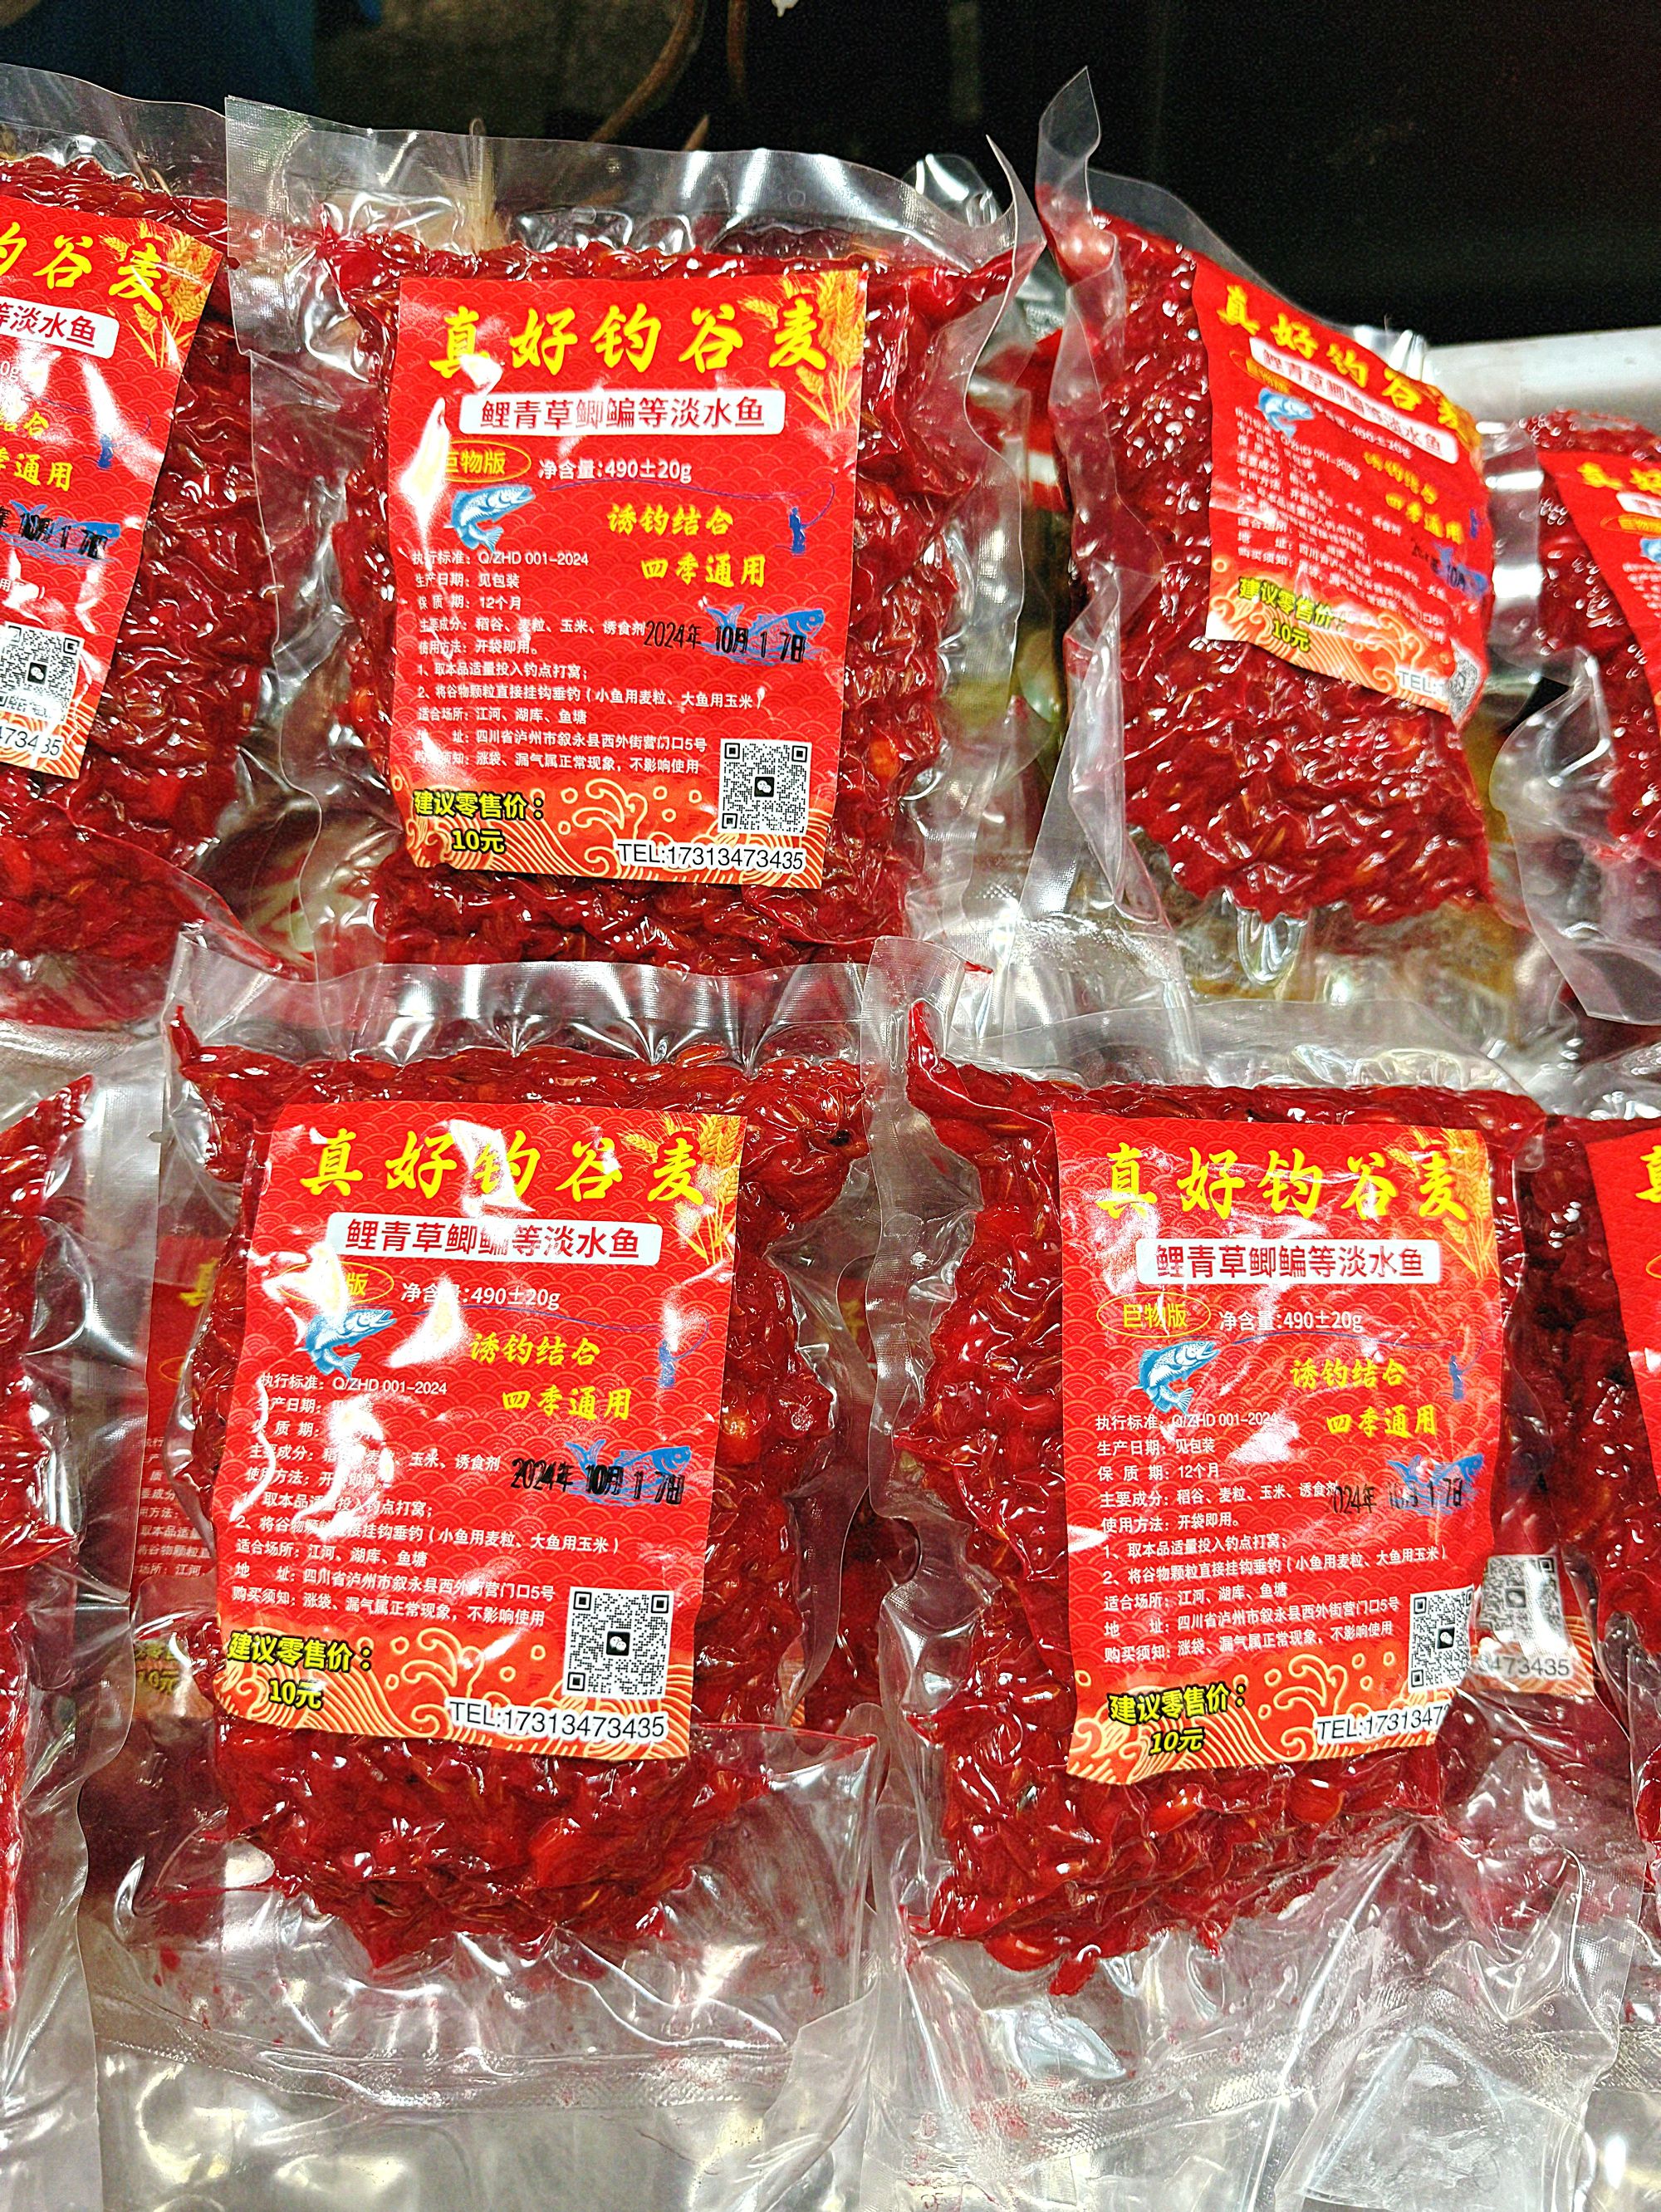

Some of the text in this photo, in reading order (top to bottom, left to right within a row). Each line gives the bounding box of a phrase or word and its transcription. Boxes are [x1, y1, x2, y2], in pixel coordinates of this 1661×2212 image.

[429, 293, 830, 377] 真好钓谷麦
[479, 396, 766, 429] 鲤青草鲫鳊等淡水鱼
[606, 503, 734, 538] 诱钓结合
[641, 552, 766, 588] 四季通用
[1272, 618, 1310, 653] 10元
[451, 827, 507, 854] 10元
[618, 843, 804, 870] TEL:17313473435
[1094, 1142, 1470, 1221] 真好钓谷麦
[1155, 1244, 1425, 1279] 鲤青草鲫鳊等淡水鱼
[1123, 1302, 1188, 1329] 巨物版
[469, 1332, 600, 1366] 诱钓结合
[1289, 1356, 1407, 1390] 诱钓结合
[502, 1384, 632, 1421] 四季通用
[1325, 1404, 1438, 1439] 四季通用
[268, 1678, 326, 1711] 10元
[449, 1701, 665, 1739] TEL:17313473435
[1148, 1725, 1205, 1756] 10元
